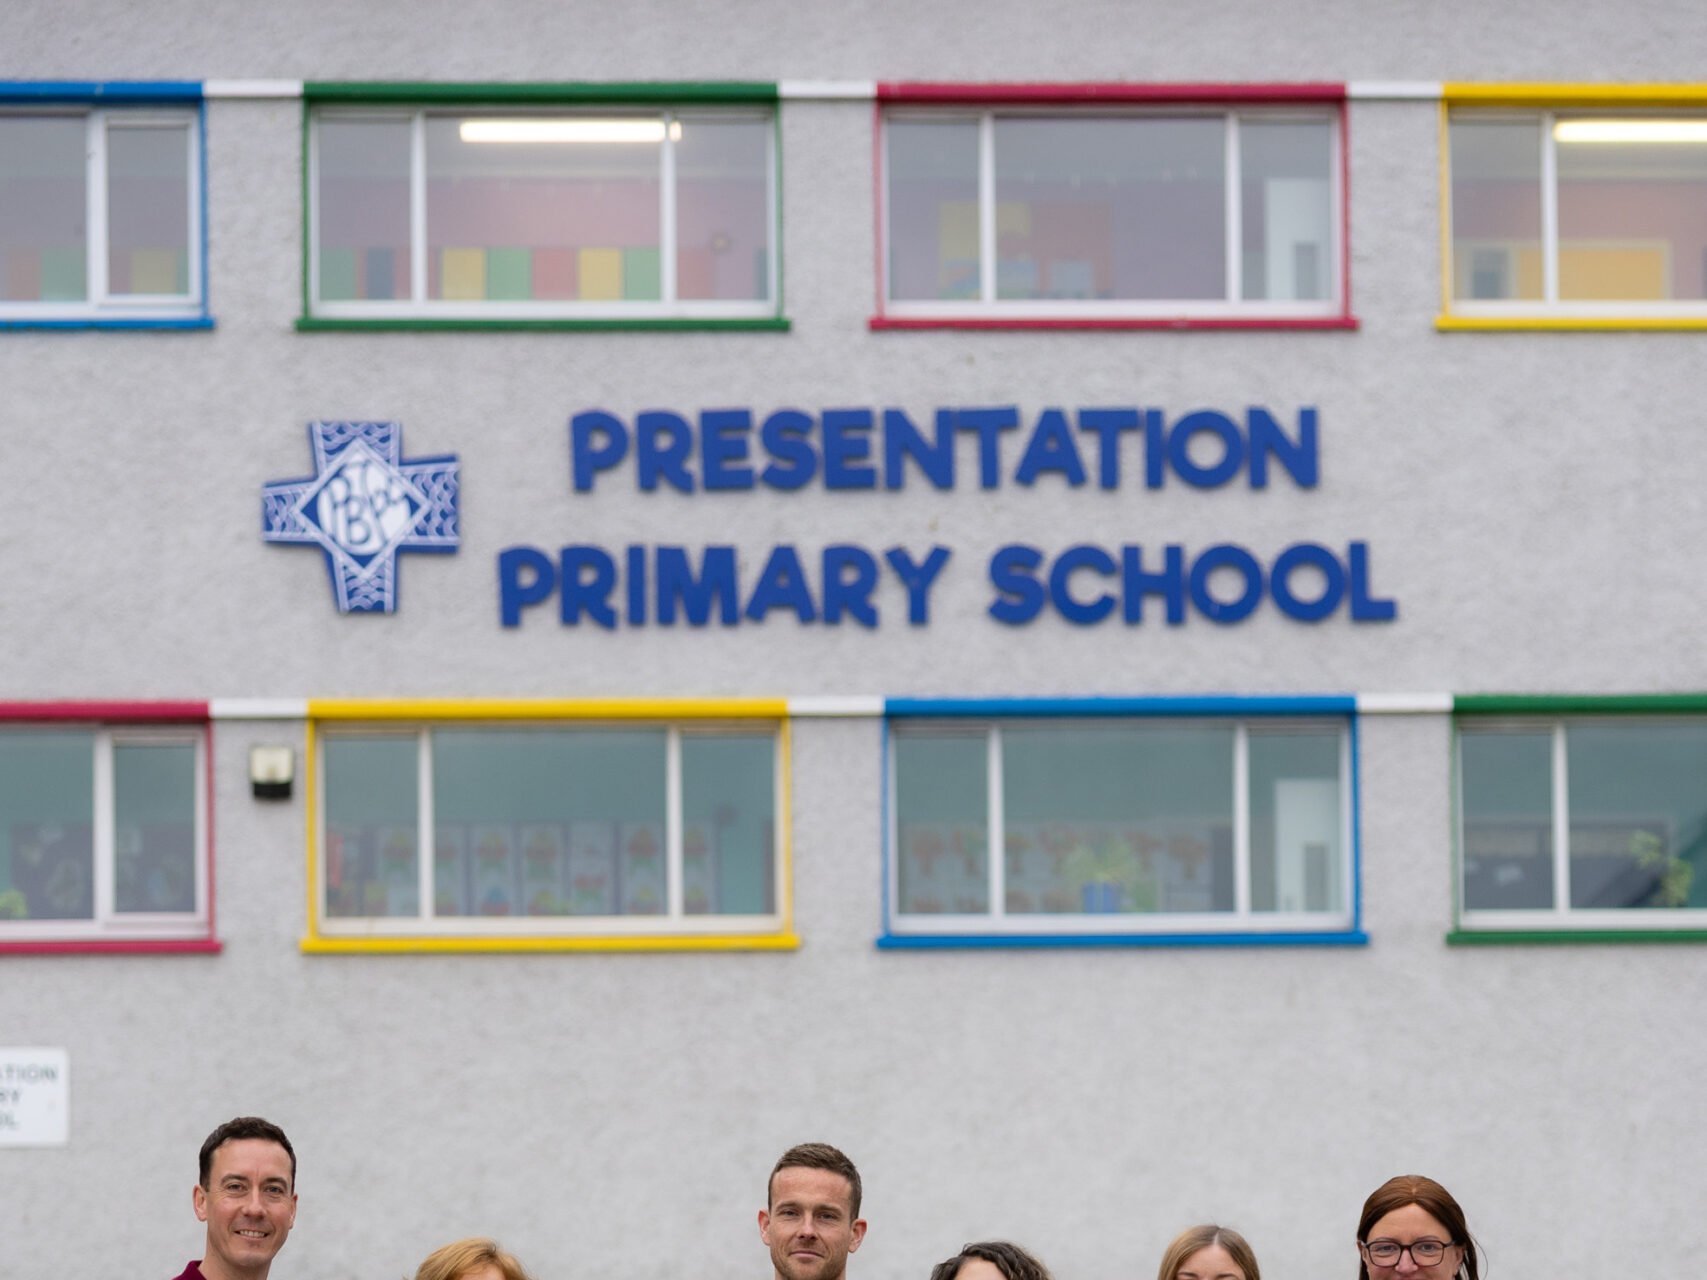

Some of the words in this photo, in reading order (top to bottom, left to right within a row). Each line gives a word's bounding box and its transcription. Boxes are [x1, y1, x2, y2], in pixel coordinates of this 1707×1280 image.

[570, 406, 1319, 493] PRESENTATION
[497, 544, 952, 629] PRIMARY
[987, 541, 1397, 625] SCHOOL
[0, 1063, 58, 1083] TION
